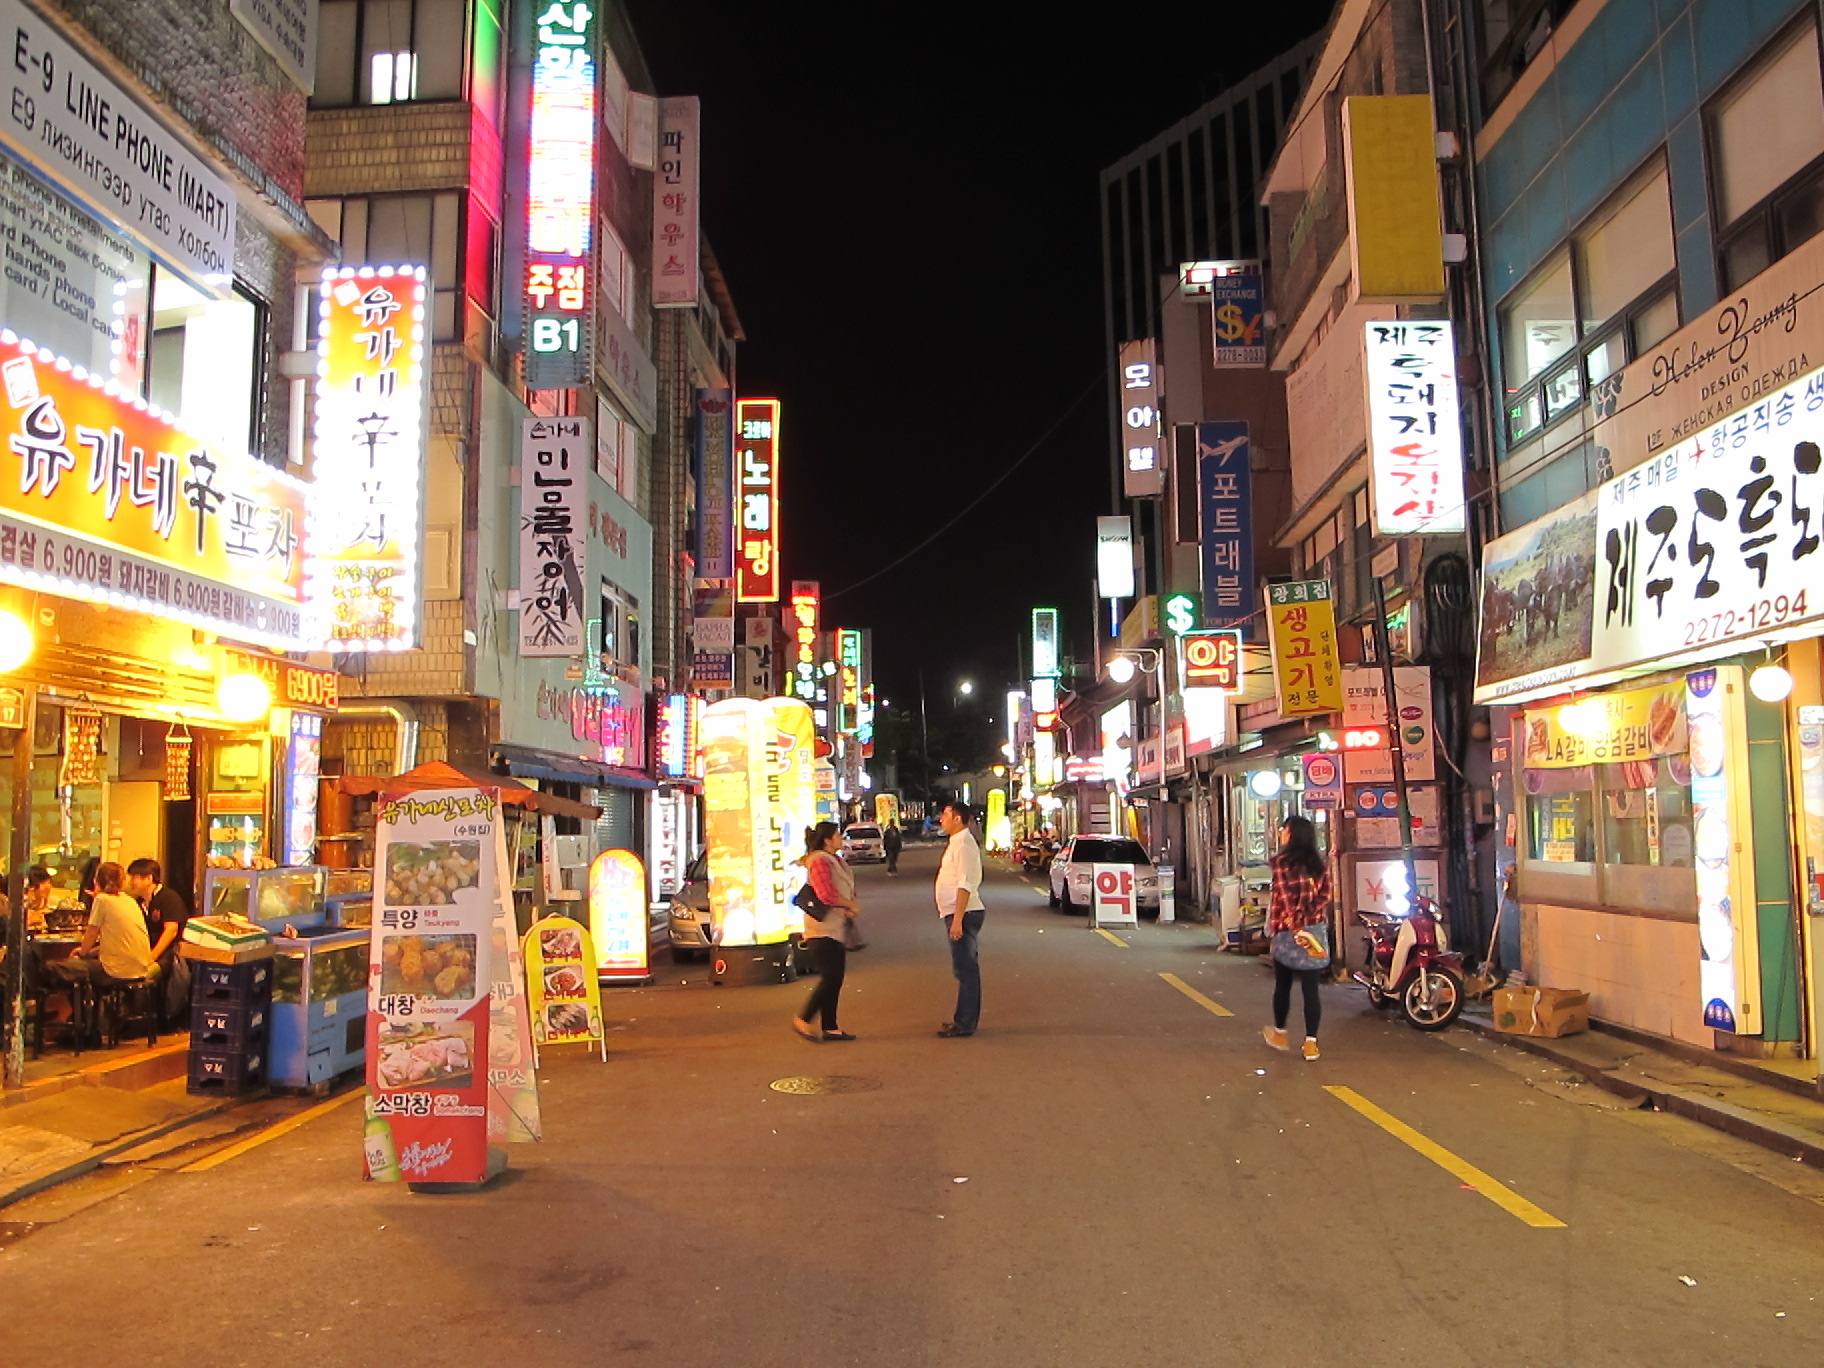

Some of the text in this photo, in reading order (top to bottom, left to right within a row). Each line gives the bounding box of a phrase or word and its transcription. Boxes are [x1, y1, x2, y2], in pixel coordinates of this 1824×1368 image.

[14, 26, 230, 242] E-9 LINE PHONE (MART)
[42, 117, 132, 208] лизингээр
[139, 193, 171, 237] утас
[179, 224, 225, 275] холбон
[22, 233, 66, 272] Phone
[4, 264, 38, 294] card
[5, 242, 96, 310] hands phone
[528, 265, 584, 310] 주점
[533, 319, 579, 352] B1
[1373, 326, 1444, 346] 제주
[1651, 293, 1798, 396] Helen Young
[1671, 352, 1810, 440] ЖЕНСКАЯ ОДЕЖДА
[1700, 362, 1750, 401] DESIGN
[530, 421, 580, 440] 손가네
[1647, 449, 1680, 487] 매일
[1711, 391, 1795, 458] 항공직송
[534, 448, 572, 621] 민물장어
[1212, 472, 1242, 607] 포트래블
[44, 539, 112, 587] 6,900원
[1684, 588, 1808, 646] 2272-1294
[1187, 640, 1236, 684] 약
[1280, 606, 1316, 688] 생고기
[287, 668, 338, 709] 6900원
[1288, 690, 1319, 705] 전문
[1097, 871, 1133, 914] 약
[381, 910, 418, 929] 특양
[379, 995, 415, 1016] 대창
[374, 1093, 430, 1114] 소막창
